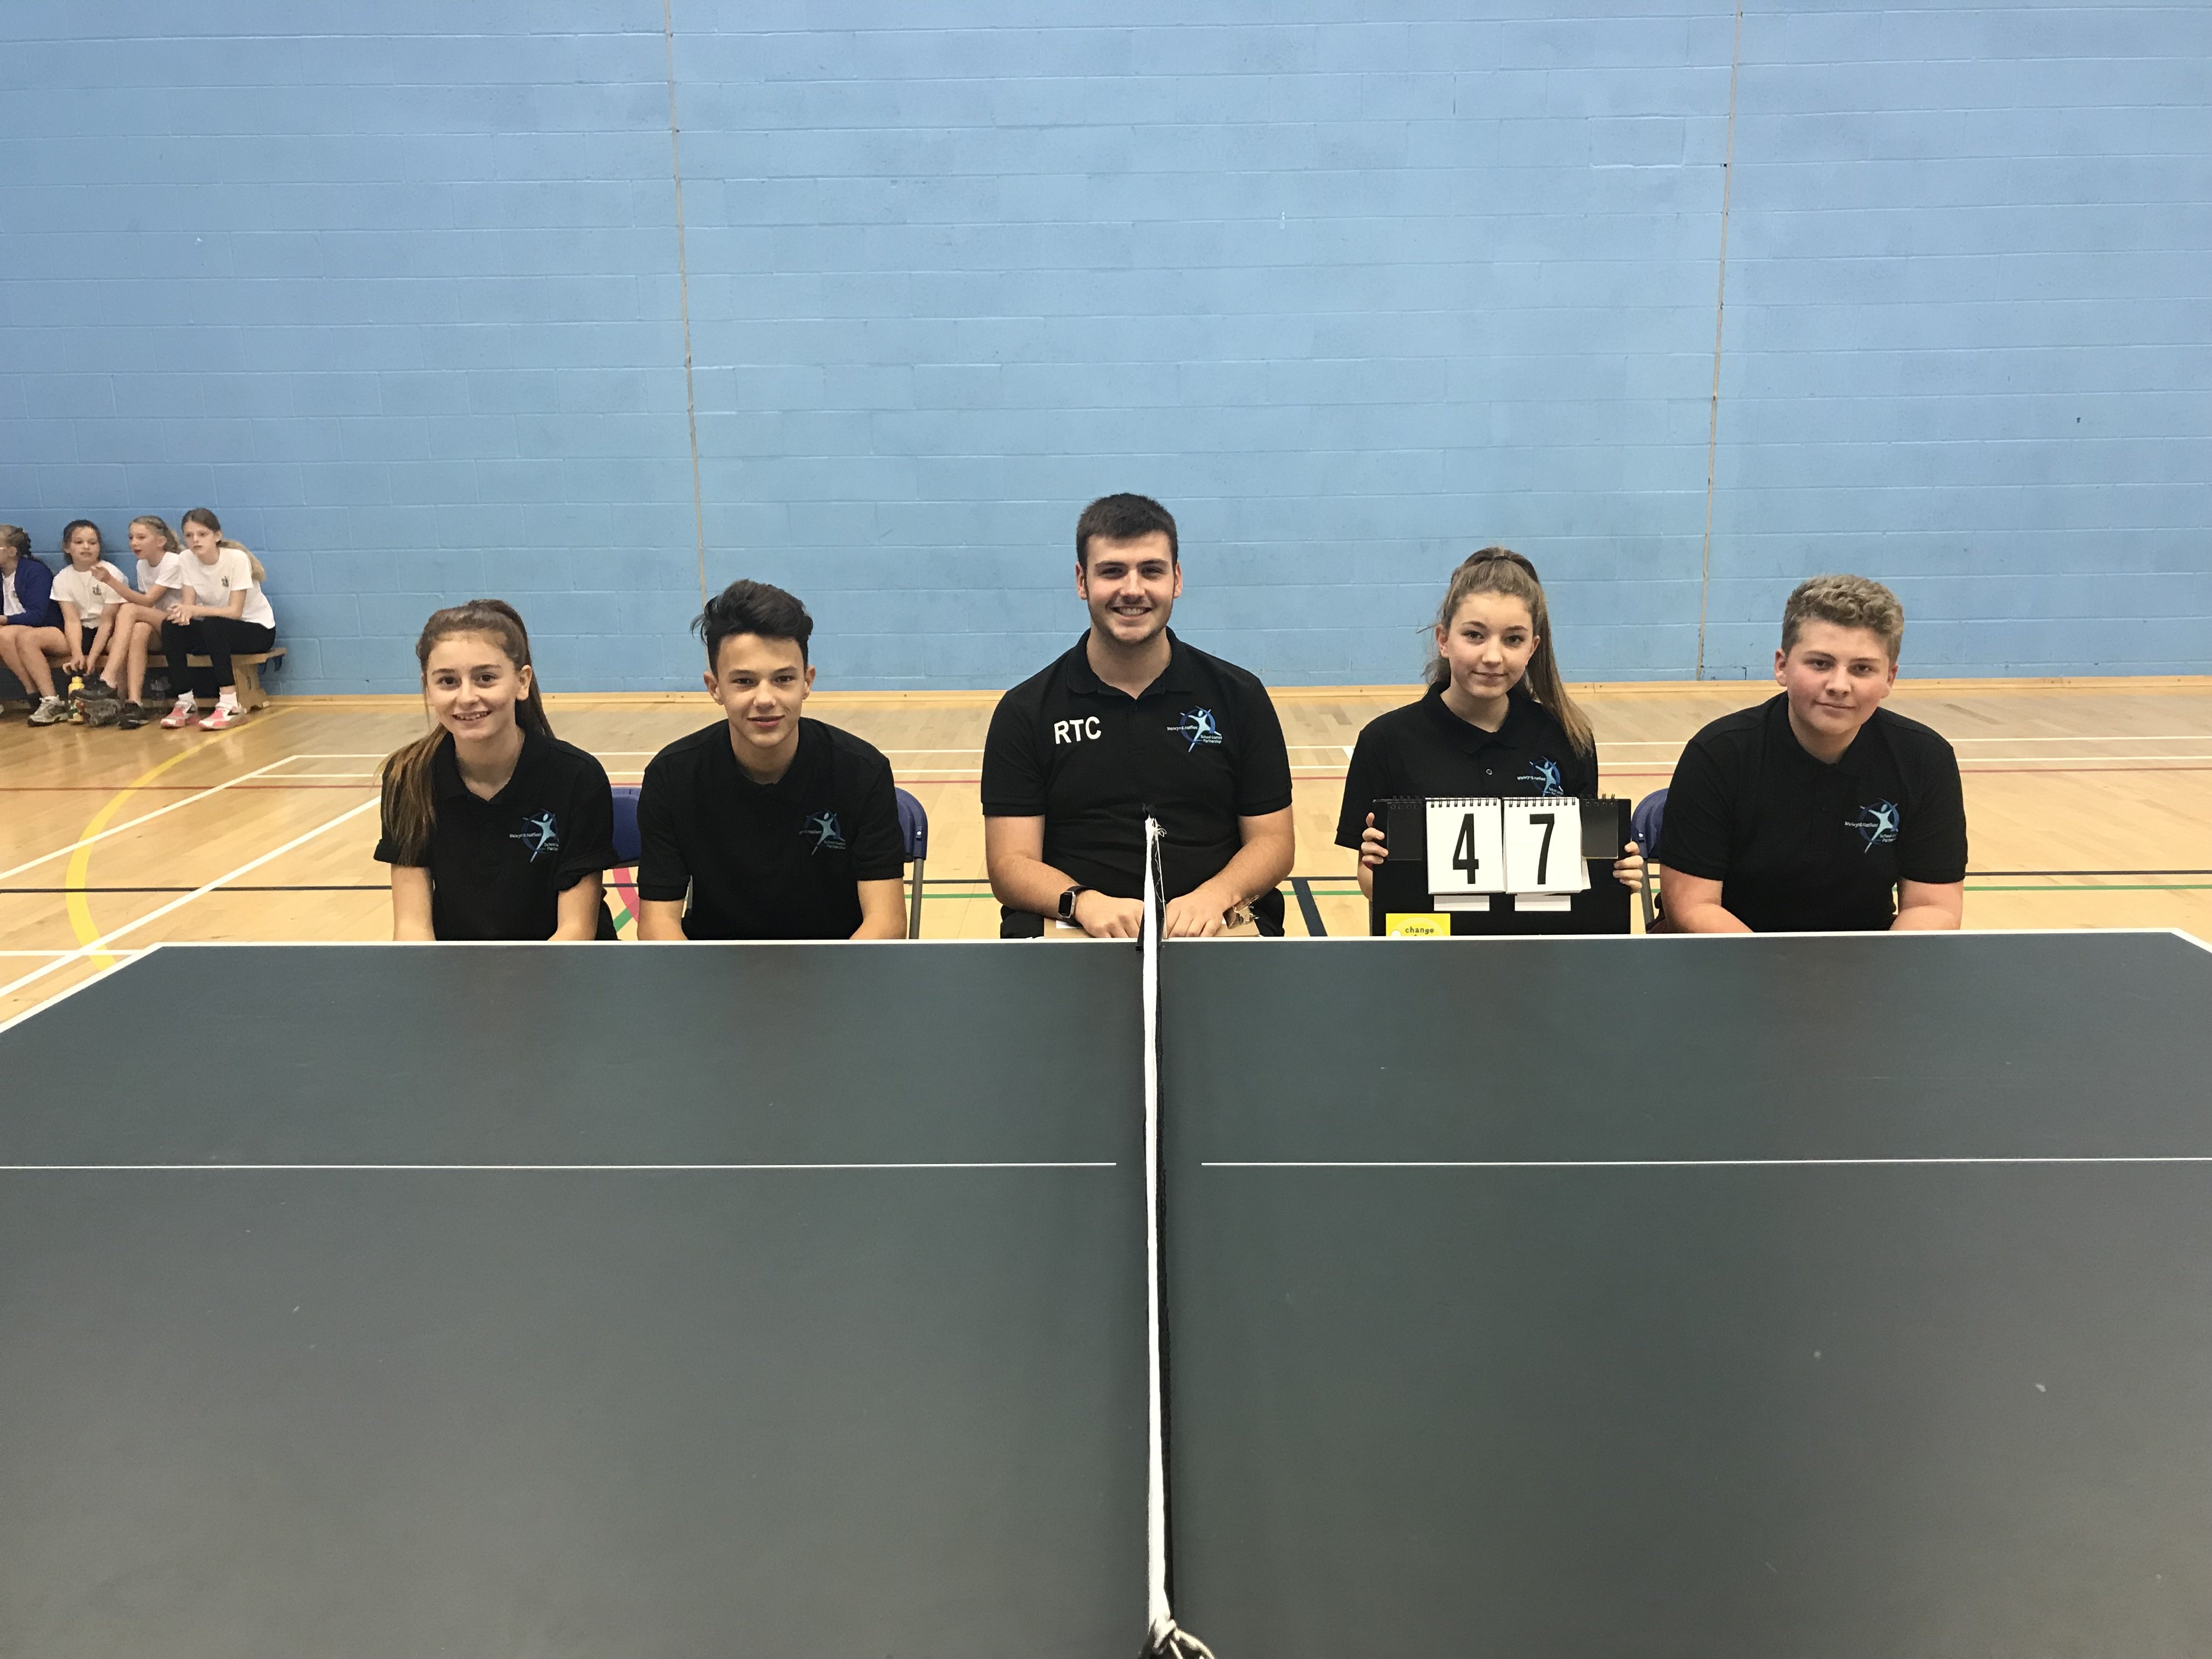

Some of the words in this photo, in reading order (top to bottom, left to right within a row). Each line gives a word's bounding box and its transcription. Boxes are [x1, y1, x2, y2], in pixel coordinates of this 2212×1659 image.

[1054, 716, 1101, 744] RTC
[1453, 814, 1479, 884] 4
[1530, 814, 1554, 884] 7
[1405, 926, 1434, 934] change
